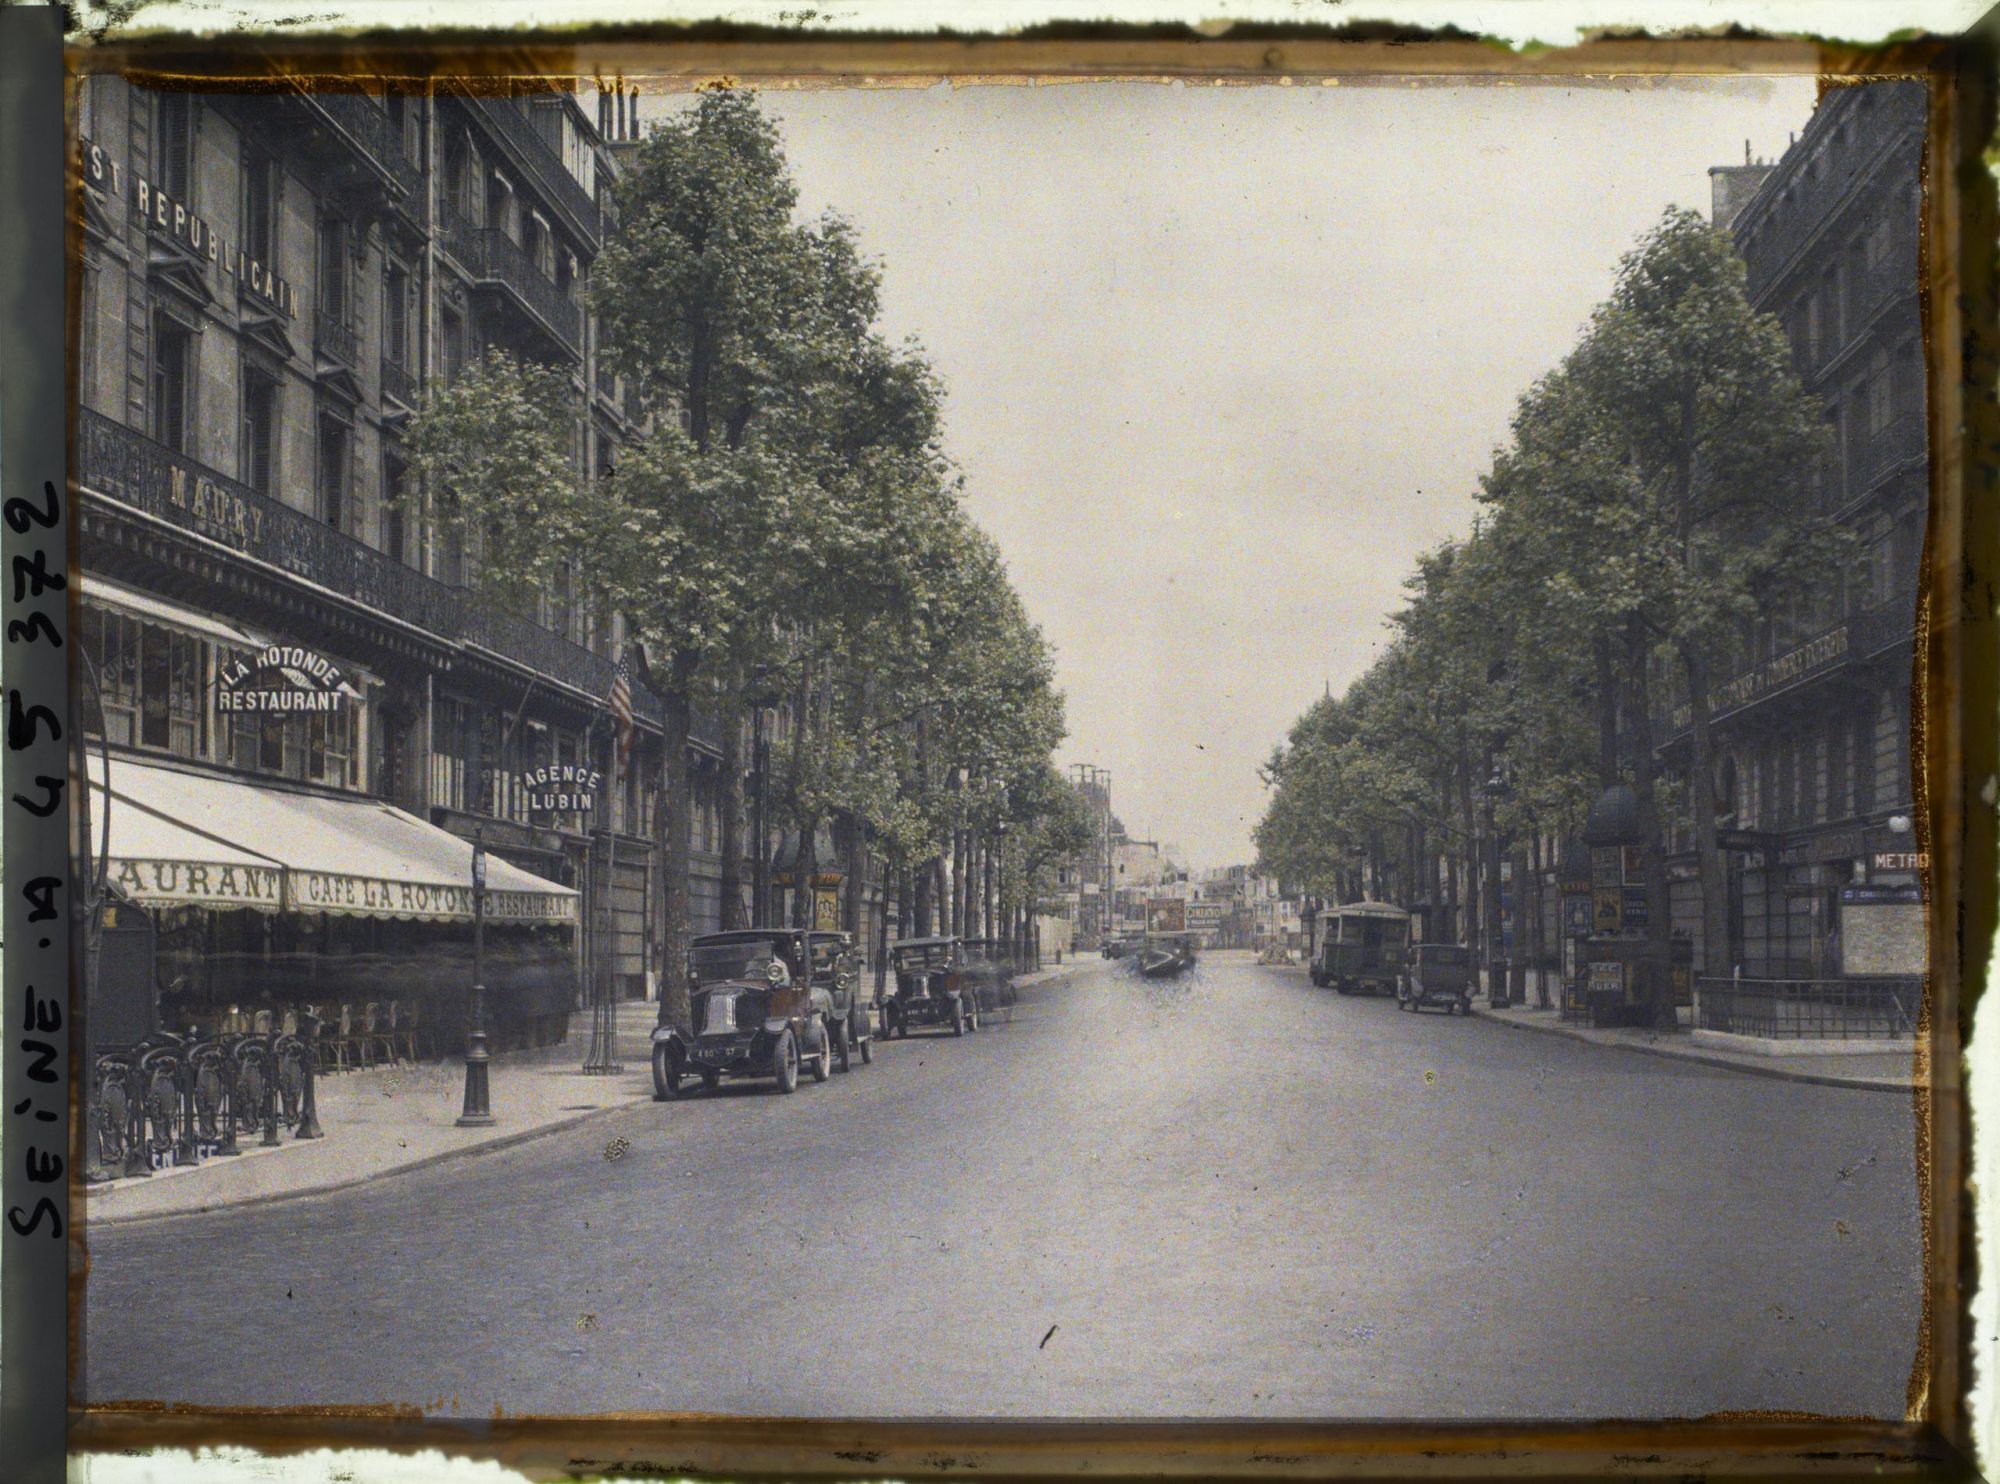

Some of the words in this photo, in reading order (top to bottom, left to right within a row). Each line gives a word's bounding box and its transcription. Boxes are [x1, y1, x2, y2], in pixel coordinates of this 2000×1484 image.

[138, 177, 298, 321] REPUBLICAIN
[170, 464, 263, 545] MAURY
[221, 659, 251, 688] LA
[256, 646, 340, 687] ROTONDE
[218, 690, 342, 712] RESTAURANT
[524, 765, 601, 789] AGENCE
[531, 793, 592, 810] LUBIN
[1875, 852, 1930, 869] METRO
[309, 874, 355, 904] CAFE
[362, 879, 393, 909] LA
[499, 892, 569, 917] RESTAURANT
